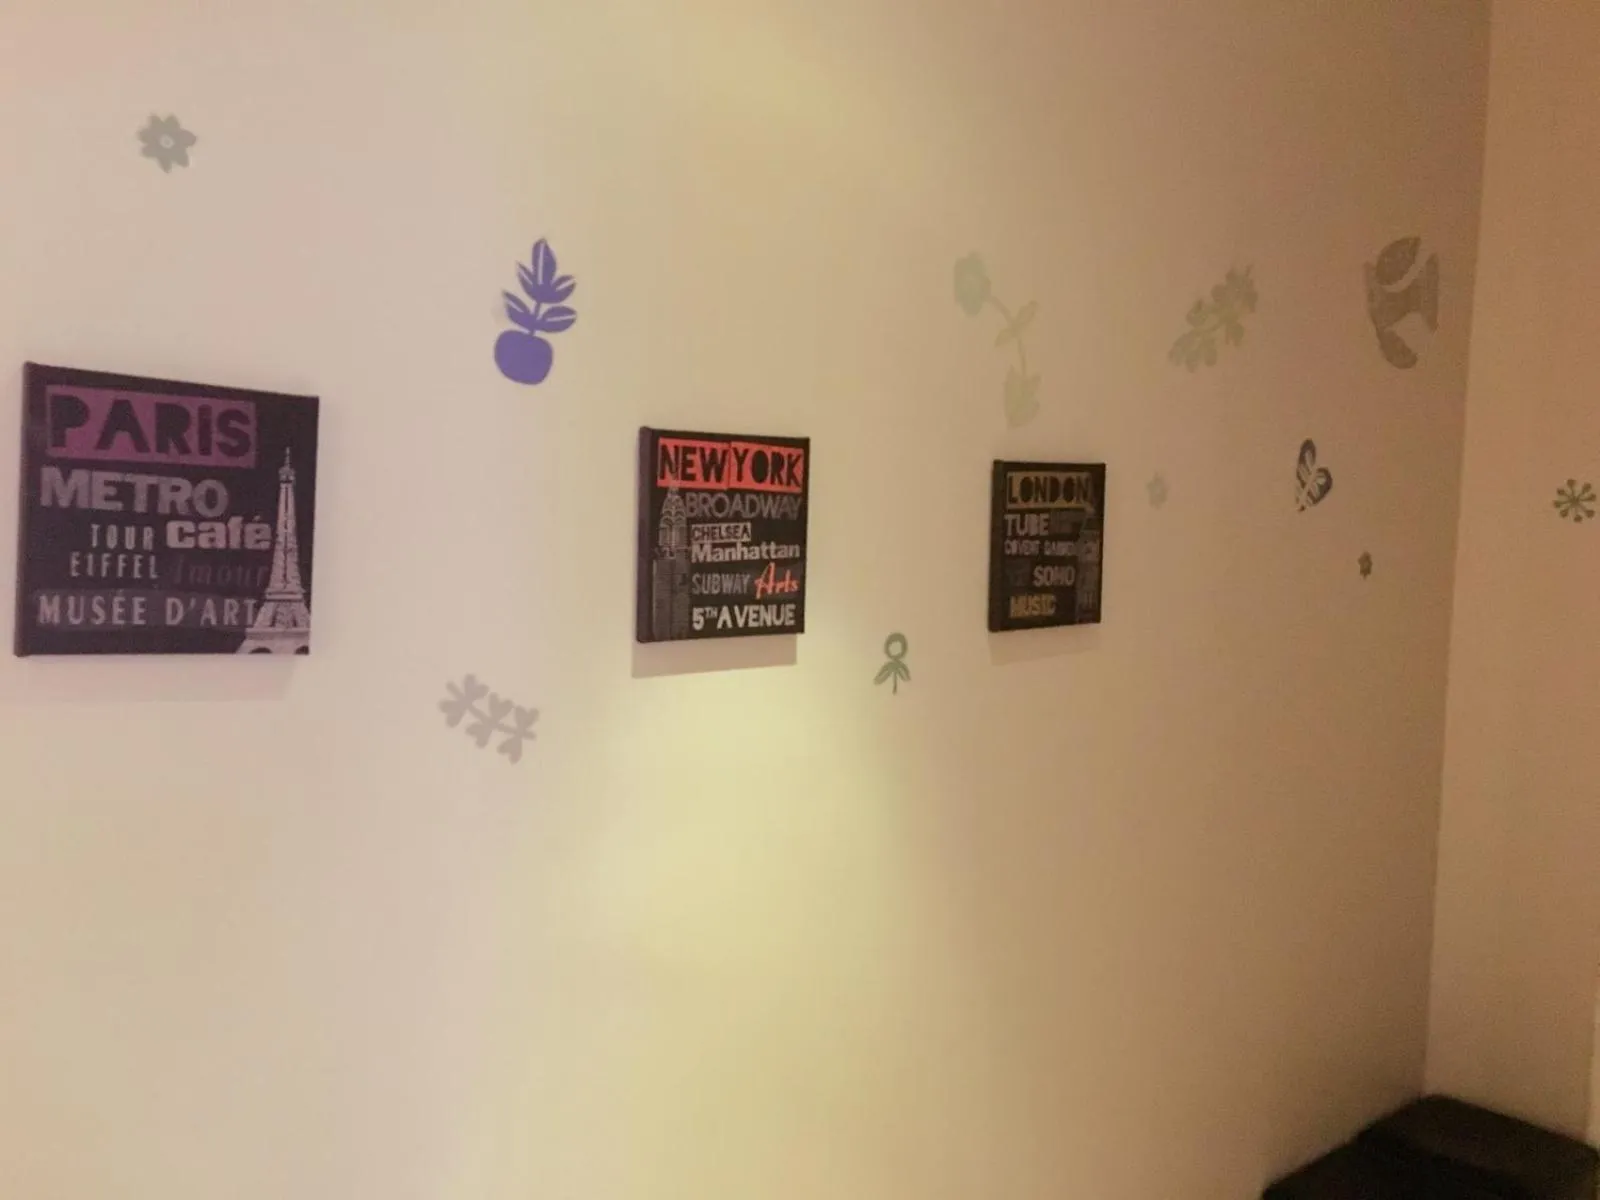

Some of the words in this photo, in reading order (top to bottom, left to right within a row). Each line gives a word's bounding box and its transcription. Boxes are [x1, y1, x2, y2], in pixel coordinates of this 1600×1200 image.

[51, 394, 251, 458] PARIS
[659, 445, 728, 483] NEW
[730, 447, 801, 487] YORK
[40, 465, 229, 518] METRO
[1009, 476, 1091, 503] LONDON
[686, 492, 802, 520] BROADWAY
[91, 523, 154, 550] TOUR
[166, 515, 273, 549] café
[692, 524, 750, 541] CHELSEA
[1004, 513, 1050, 536] TUBE
[70, 551, 159, 579] EIFFEL
[691, 541, 800, 563] Manhattan
[692, 573, 750, 595] SUBWAY
[754, 562, 799, 600] Arts
[37, 590, 147, 626] MUSÉE
[165, 596, 257, 627] D'ART
[692, 606, 718, 630] 5TH
[717, 604, 796, 629] AVENUE
[1010, 594, 1056, 617] MUSIC
